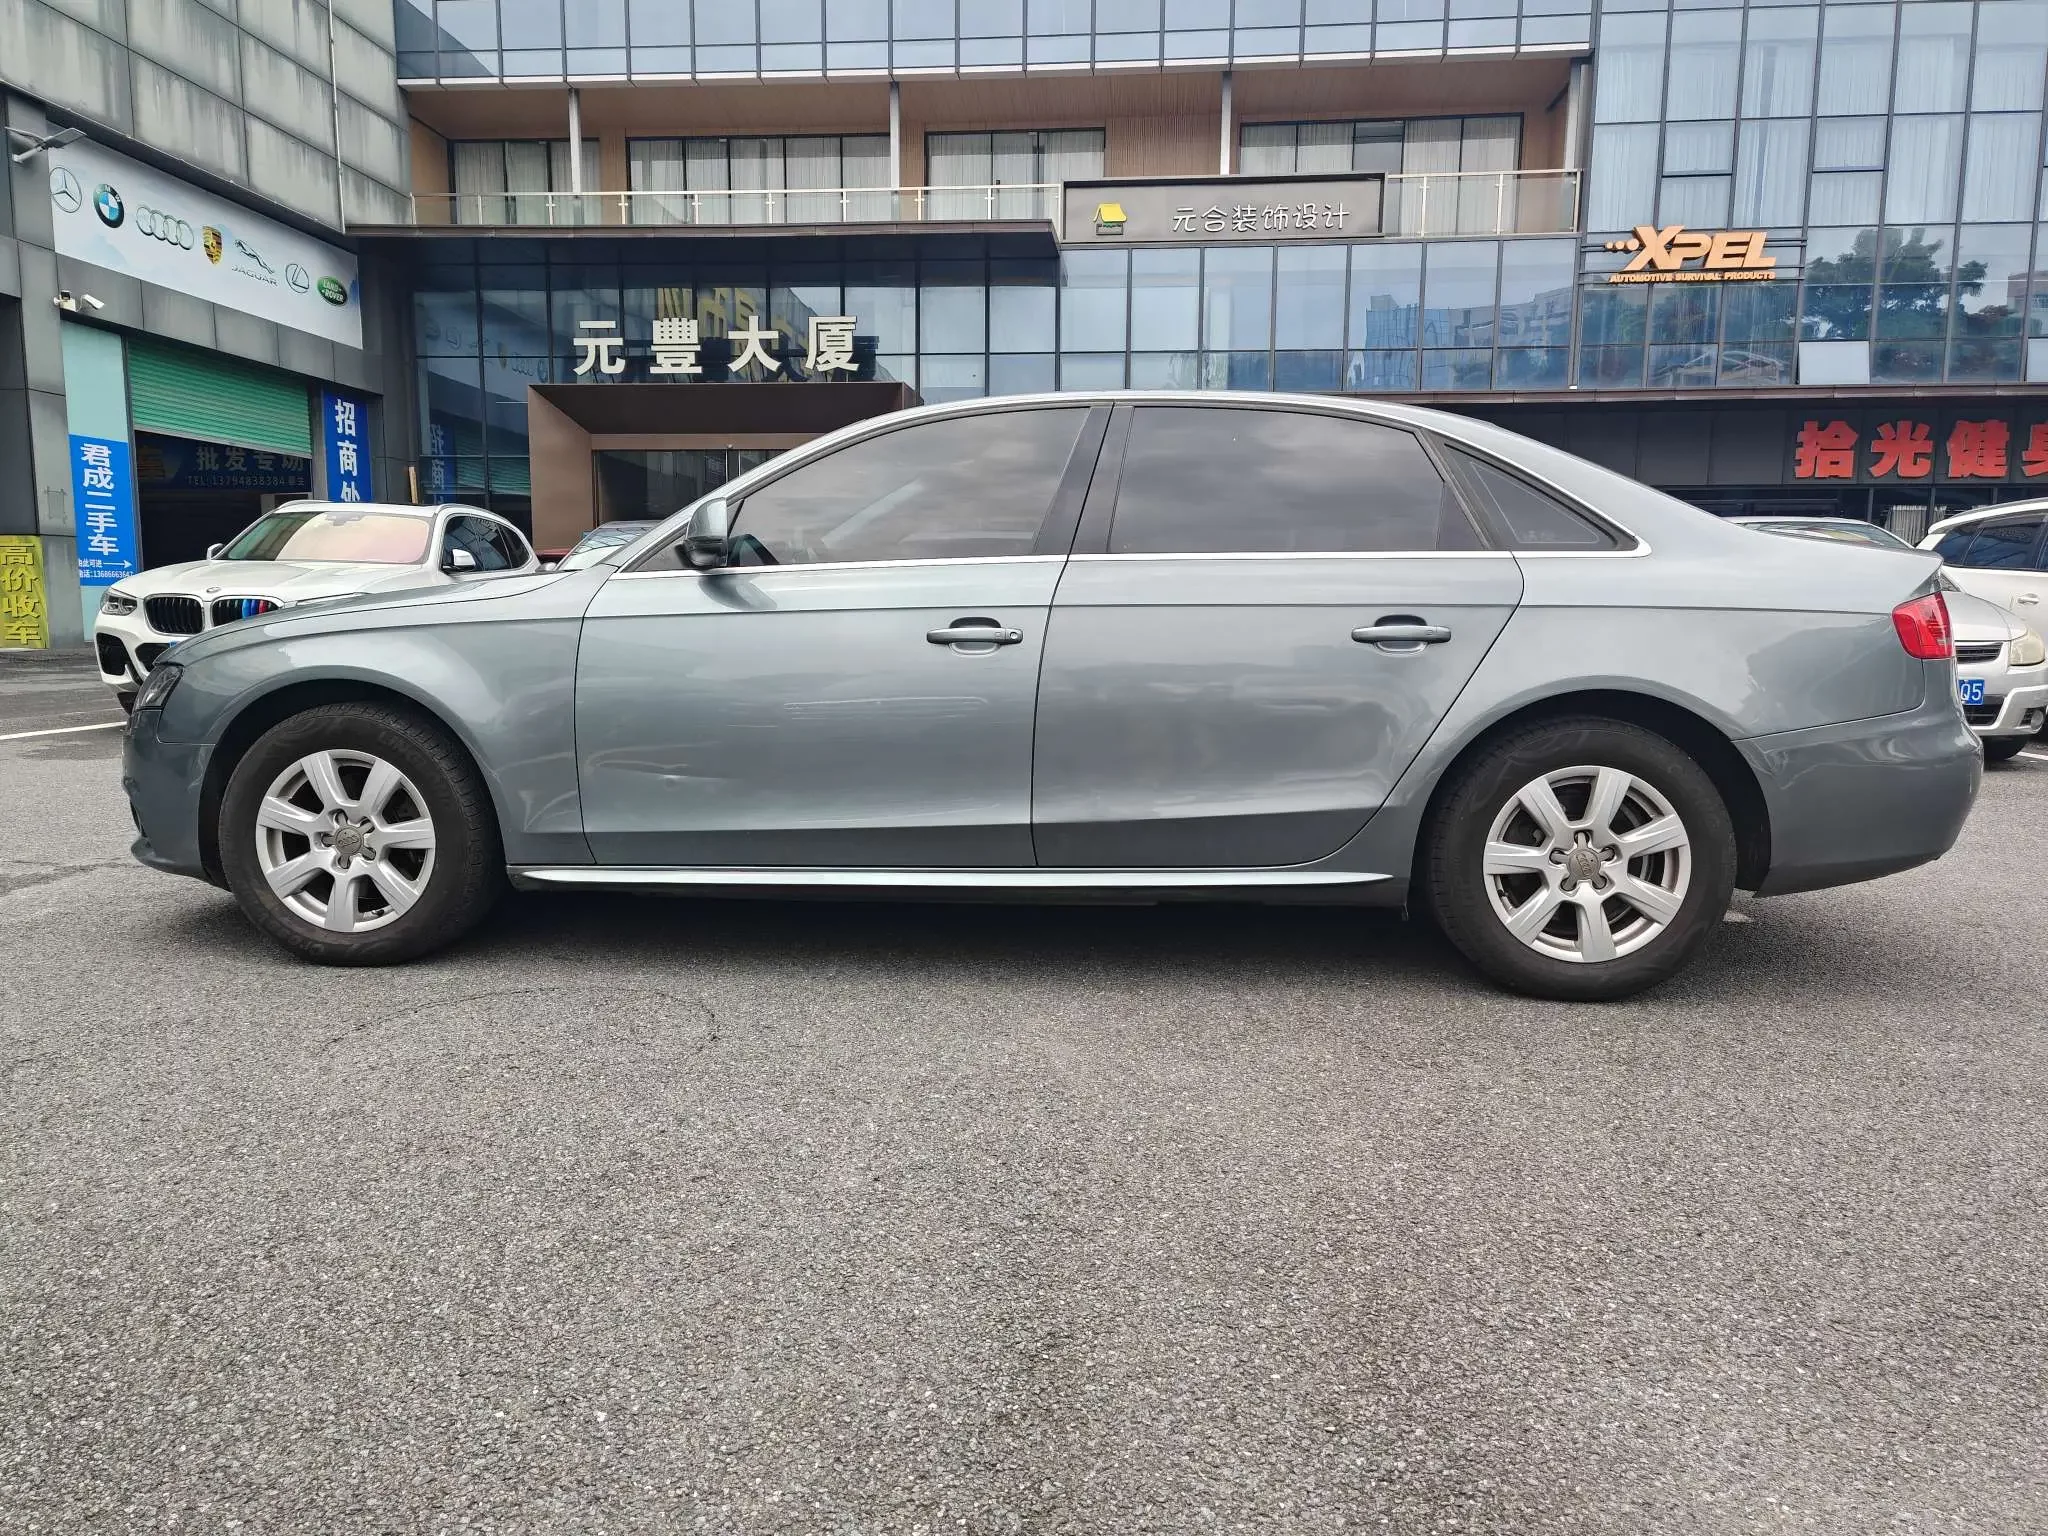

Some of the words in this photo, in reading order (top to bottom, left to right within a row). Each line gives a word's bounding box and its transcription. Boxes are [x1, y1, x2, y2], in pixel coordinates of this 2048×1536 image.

[1173, 202, 1351, 232] 元合装饰设计
[1622, 224, 1777, 272] XPEL
[231, 264, 278, 287] JAGUAR
[323, 279, 339, 292] LAND
[1609, 272, 1673, 283] AUTOMOTIVE
[1676, 272, 1721, 281] SURVIVAL
[1725, 271, 1776, 280] PRODUCTS
[325, 289, 344, 302] ROVER
[573, 316, 860, 376] 元豐大厦
[80, 443, 119, 555] 君成二手车
[0, 543, 41, 645] 高价收车
